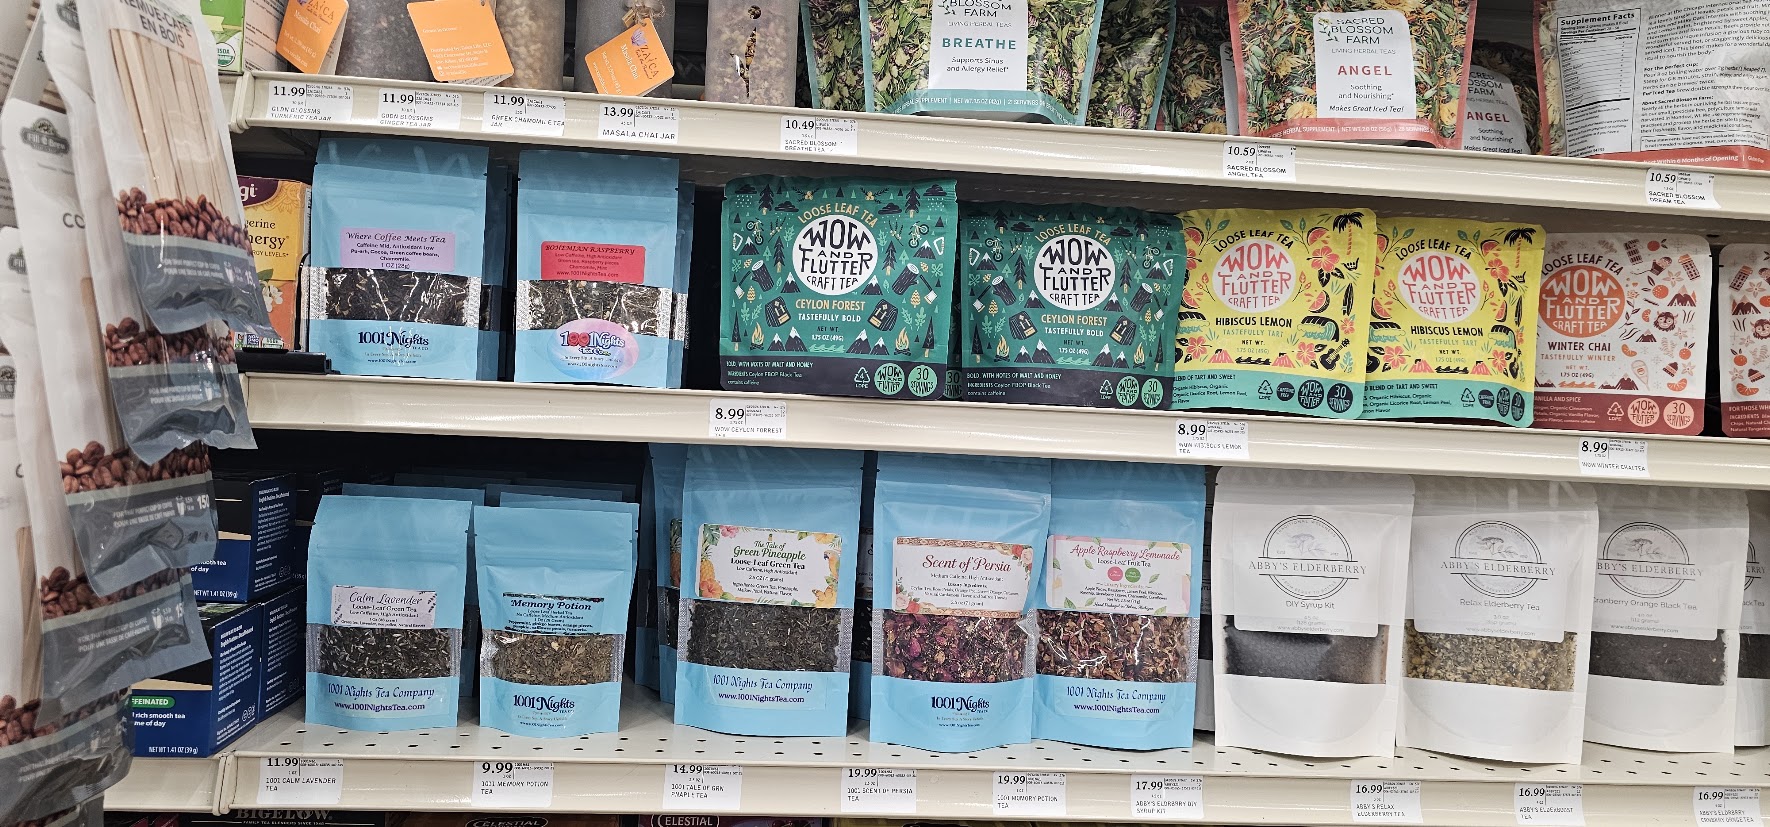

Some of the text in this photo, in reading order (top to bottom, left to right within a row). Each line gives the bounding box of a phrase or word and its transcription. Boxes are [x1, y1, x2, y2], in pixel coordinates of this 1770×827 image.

[964, 8, 998, 18] FARM
[1561, 12, 1635, 26] Supplement Facts
[1336, 17, 1385, 25] SACRED
[139, 14, 185, 49] EN BOIS
[1331, 25, 1394, 35] BLOSSOM
[942, 37, 1017, 50] BREATHE
[1346, 35, 1380, 45] FARM
[951, 56, 1004, 66] Supports Sinus
[1337, 65, 1393, 76] ANGEL
[273, 86, 305, 97] 11.99
[1350, 83, 1383, 92] Soothing
[382, 92, 414, 105] 11.99
[493, 94, 525, 107] 11.99
[1338, 92, 1352, 100] and
[603, 106, 634, 118] 13.99
[1329, 104, 1405, 113] Makes Great Iced Tea!
[1467, 110, 1510, 123] ANGEL
[785, 119, 814, 131] 10.49
[603, 129, 636, 137] MASALA
[659, 132, 676, 140] JAR
[1227, 146, 1255, 157] 10.59
[1649, 172, 1676, 183] 10.59
[798, 202, 878, 228] LOOSE LEAF TEA
[346, 232, 371, 240] Where
[374, 232, 402, 242] Coffee
[430, 235, 446, 243] Tea
[802, 219, 871, 251] WOW
[1035, 223, 1111, 246] LOOSE LEAF TEA
[1213, 230, 1245, 252] LOOSE
[1277, 232, 1295, 249] TEA
[590, 246, 635, 255] RASPBERRY
[817, 250, 853, 259] AND
[1042, 238, 1108, 267] WOW
[1396, 239, 1472, 261] LOOSE LEAF TEA
[799, 244, 873, 276] FLUTTER
[1221, 242, 1289, 272] WOW
[1403, 255, 1470, 282] WOW
[1541, 253, 1624, 276] LOOSE LEAF TEA
[1039, 262, 1112, 292] FLUTTER
[1058, 267, 1093, 275] AND
[1237, 271, 1273, 279] AND
[806, 275, 859, 291] CRAFT TEA
[1218, 272, 1292, 296] FLUTTER
[1545, 268, 1617, 296] WOW
[1402, 280, 1476, 306] FLUTTER
[795, 299, 866, 311] CEYLON FOREST
[1049, 293, 1100, 306] CRAFT TEA
[1228, 296, 1280, 309] CRAFT TEA
[1563, 297, 1600, 305] AND
[1419, 306, 1468, 319] CRAFT TEA
[1542, 293, 1621, 320] FLUTTER
[798, 313, 861, 322] TASTEFULLY BOLD
[1041, 314, 1107, 326] CEYLON FOREST
[1216, 317, 1292, 328] HIBISCUS LEMON
[1411, 325, 1484, 336] HIBISCUS LEMON
[1552, 321, 1607, 334] CRAFT TEA
[1548, 341, 1611, 352] WINTER CHAI
[918, 367, 929, 379] 30
[715, 408, 744, 420] 8.99
[1673, 403, 1686, 414] 30
[1178, 424, 1205, 435] 8.99
[1581, 441, 1608, 453] 8.99
[733, 546, 806, 561] Green Pineapple
[1070, 544, 1180, 561] Apple Raspberry Lemonade
[922, 554, 1011, 573] Scent of Persia
[1249, 561, 1367, 575] ABBY'S ELDERBERRY
[1441, 561, 1556, 576] ABBY'S ELDERBERRY
[350, 592, 423, 605] Calm Lavender
[1631, 599, 1659, 608] Orange
[1660, 601, 1681, 610] Black
[511, 599, 591, 611] Memory Potion
[1300, 601, 1323, 609] Syrup
[1325, 601, 1335, 609] Kit
[1484, 600, 1525, 611] Elderberry
[1527, 603, 1540, 611] Tea
[328, 683, 435, 700] 1001 Nights Tea Company
[718, 692, 804, 703] www.1001NightsTea.com
[1066, 685, 1167, 703] 1001 Nights Tea Company
[334, 702, 425, 712] www.1001NightsTea.com
[1074, 704, 1160, 714] www.1001NightsTea.com
[267, 758, 298, 767] 11.99
[482, 762, 513, 774] 9.99
[672, 764, 702, 774] 14.99
[848, 768, 877, 778] 19.99
[997, 775, 1025, 785] 19.99
[1136, 781, 1163, 791] 17.99
[1355, 784, 1382, 794] 16.99
[1519, 788, 1545, 797] 16.99
[1698, 791, 1724, 801] 16.99
